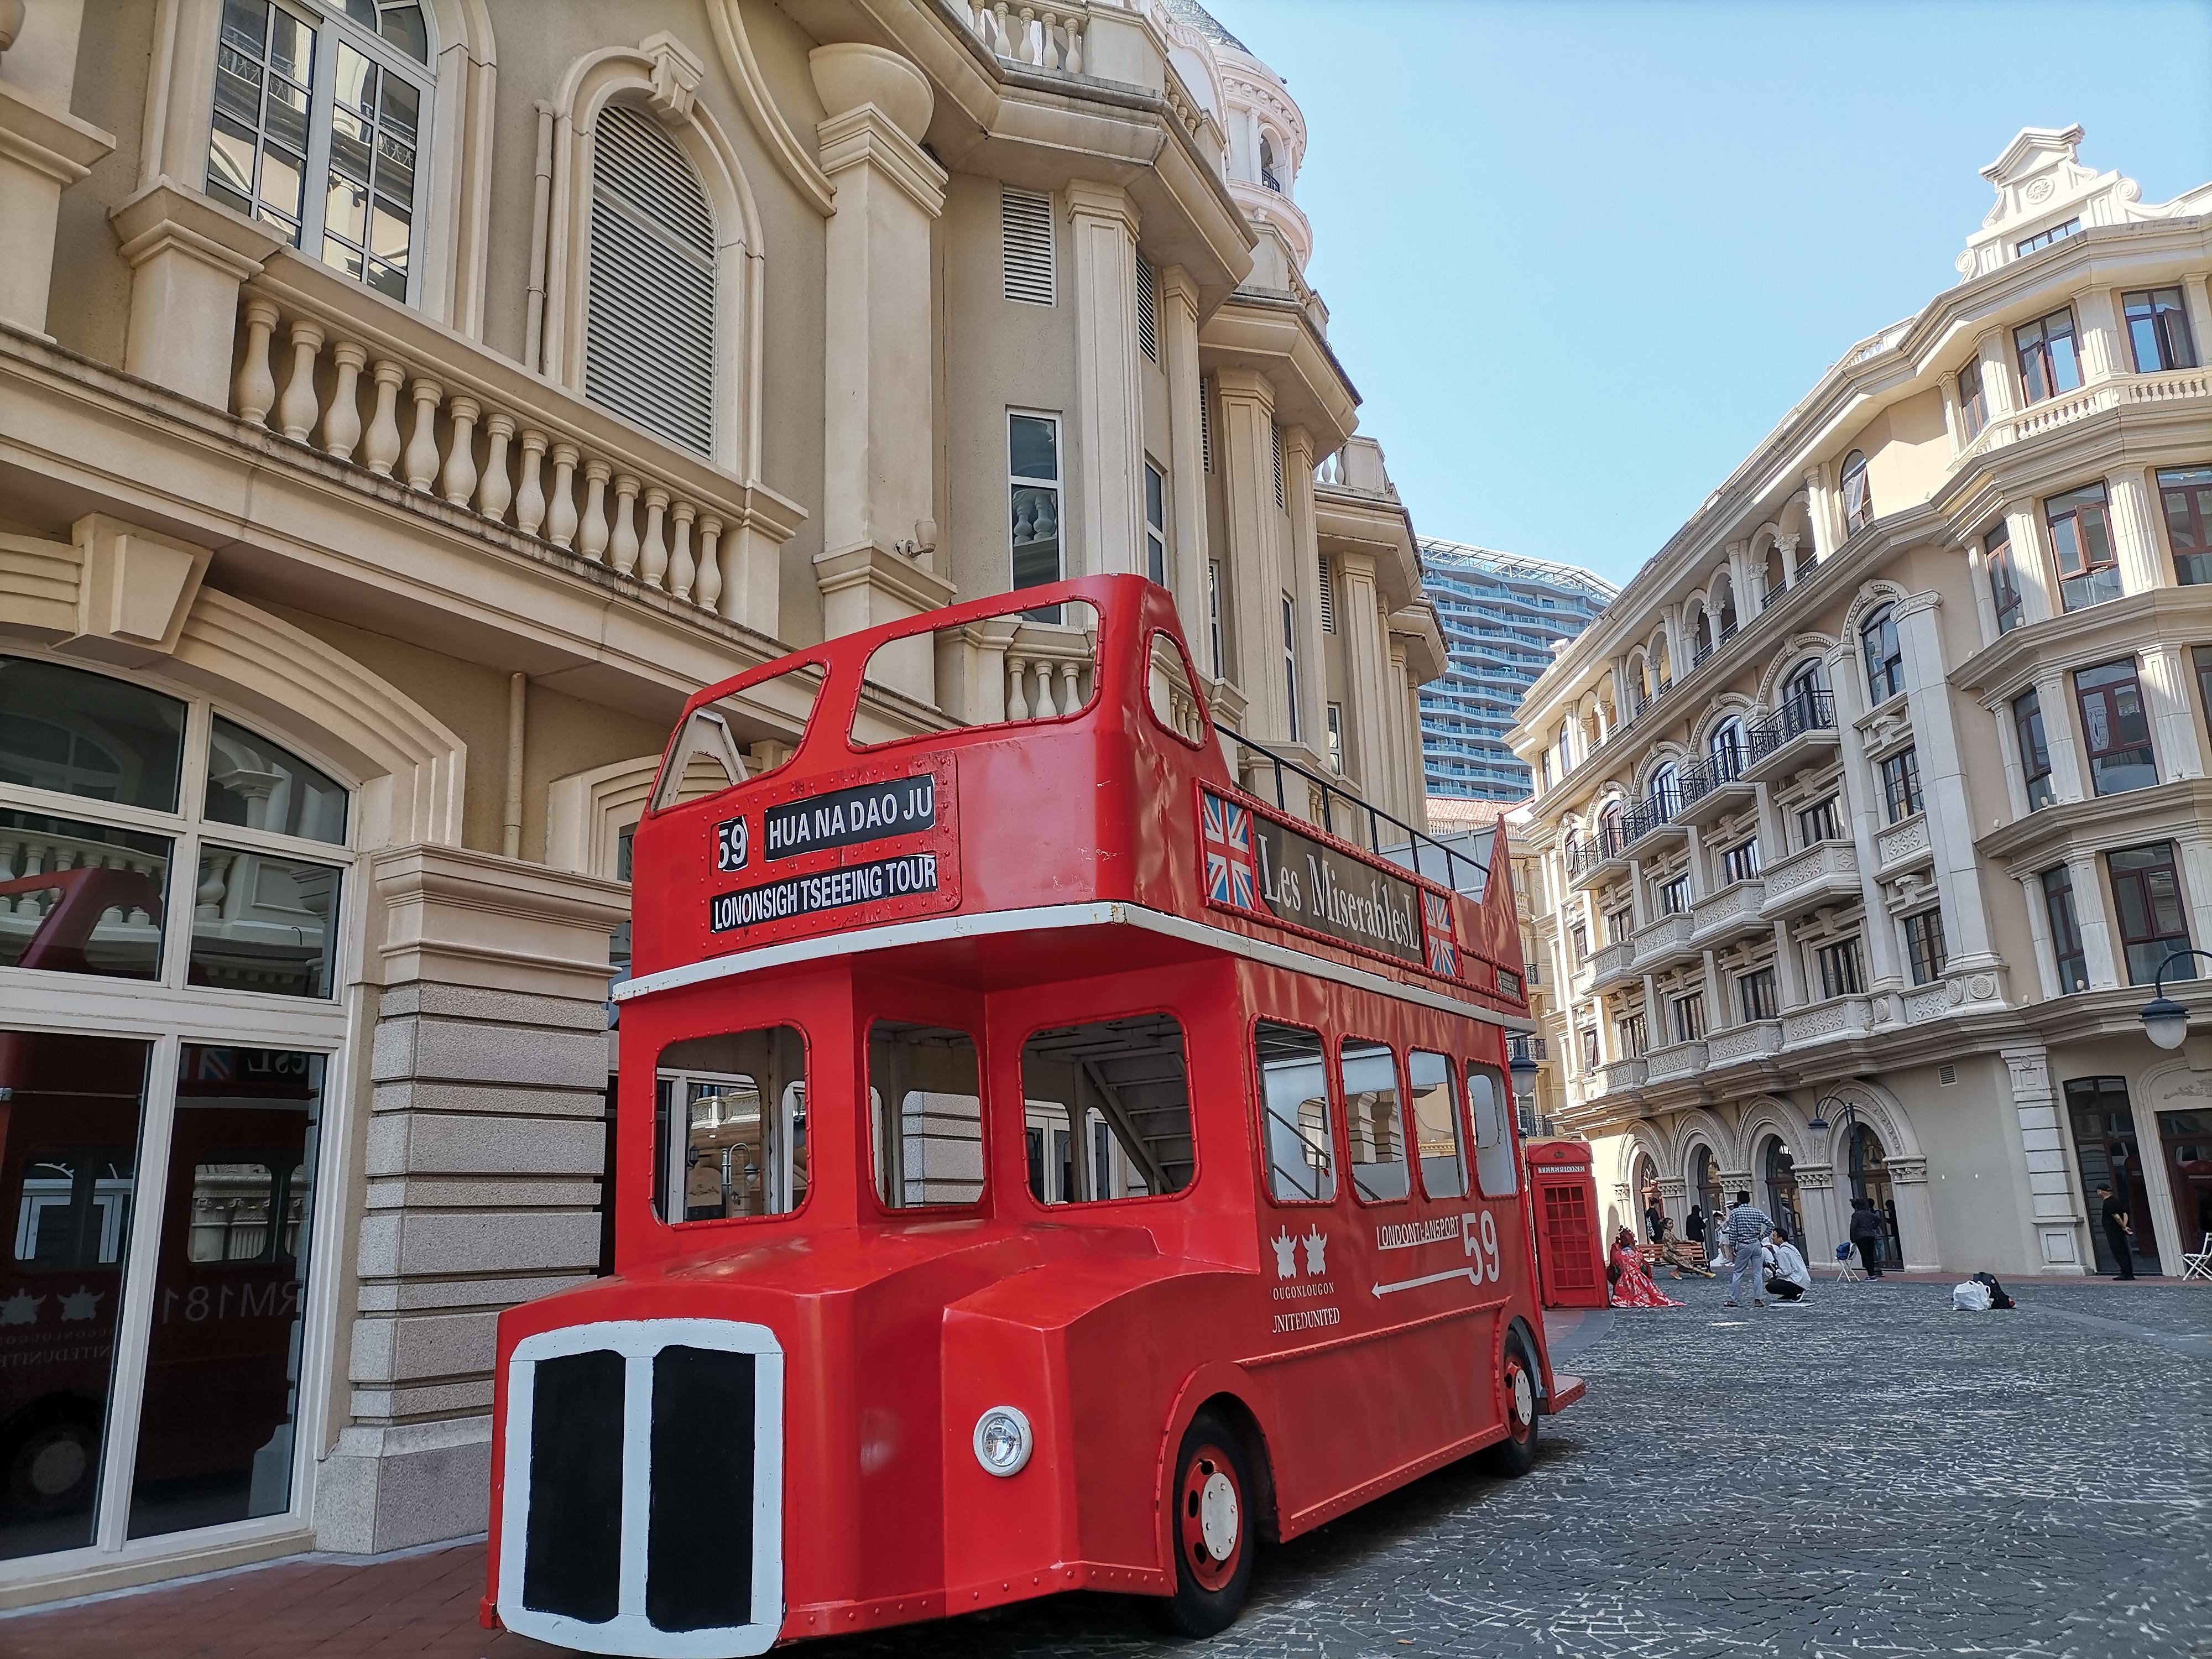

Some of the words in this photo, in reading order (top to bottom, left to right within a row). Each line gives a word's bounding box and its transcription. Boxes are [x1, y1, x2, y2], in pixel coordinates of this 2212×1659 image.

[718, 824, 746, 868] 59
[770, 813, 811, 849] HUA
[816, 805, 846, 839] NA
[851, 794, 897, 831] DAO
[903, 786, 932, 820] JU
[715, 883, 797, 930] LONONSIGH
[800, 866, 882, 910] TSEEEING
[885, 858, 937, 893] TOUR
[1258, 834, 1301, 911] Les
[1462, 1210, 1500, 1286] 59
